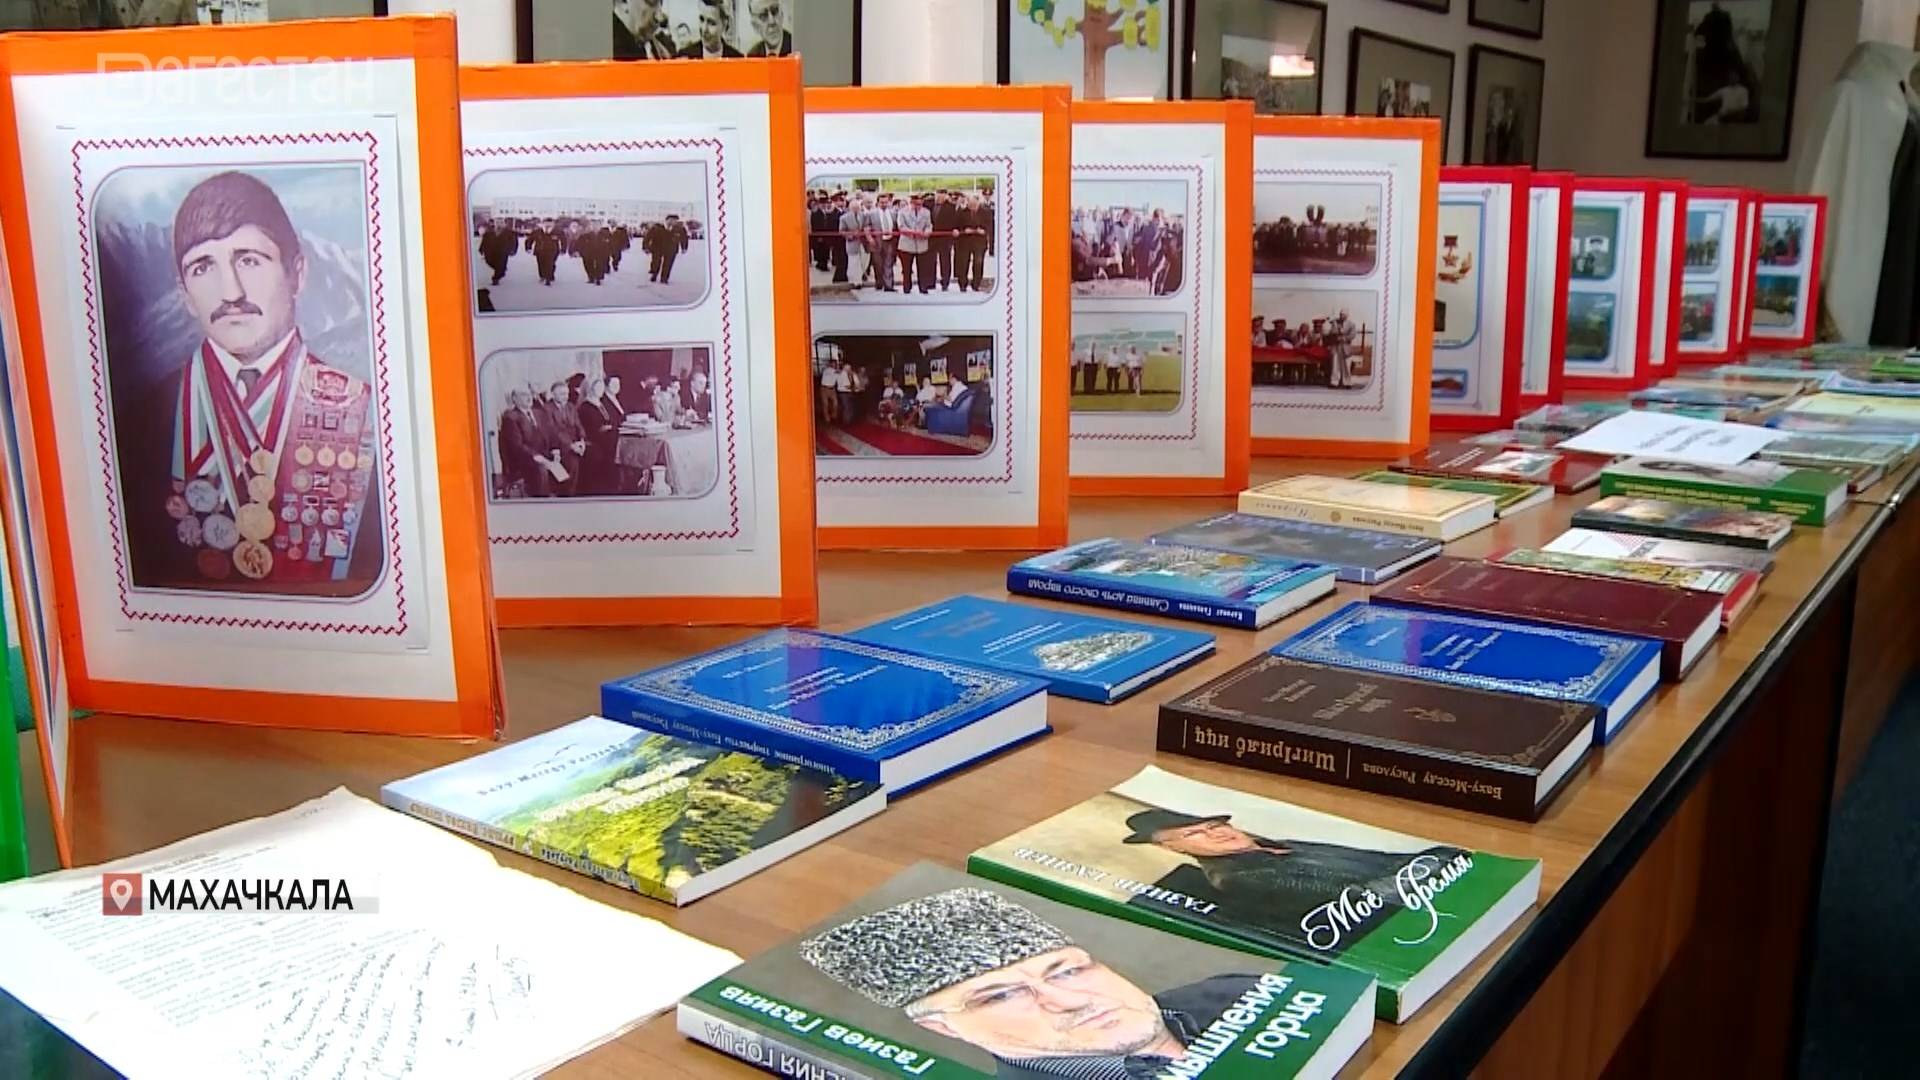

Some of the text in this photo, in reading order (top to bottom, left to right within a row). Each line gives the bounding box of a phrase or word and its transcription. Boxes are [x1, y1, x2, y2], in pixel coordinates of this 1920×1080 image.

[1193, 725, 1231, 749] ицц
[1362, 762, 1504, 801] Баху-Меседу Расулова
[1300, 886, 1384, 950] Моё
[703, 1019, 775, 1071] ГОРЦА
[719, 984, 936, 1076] Газиев Газияв
[1244, 991, 1328, 1060] горца
